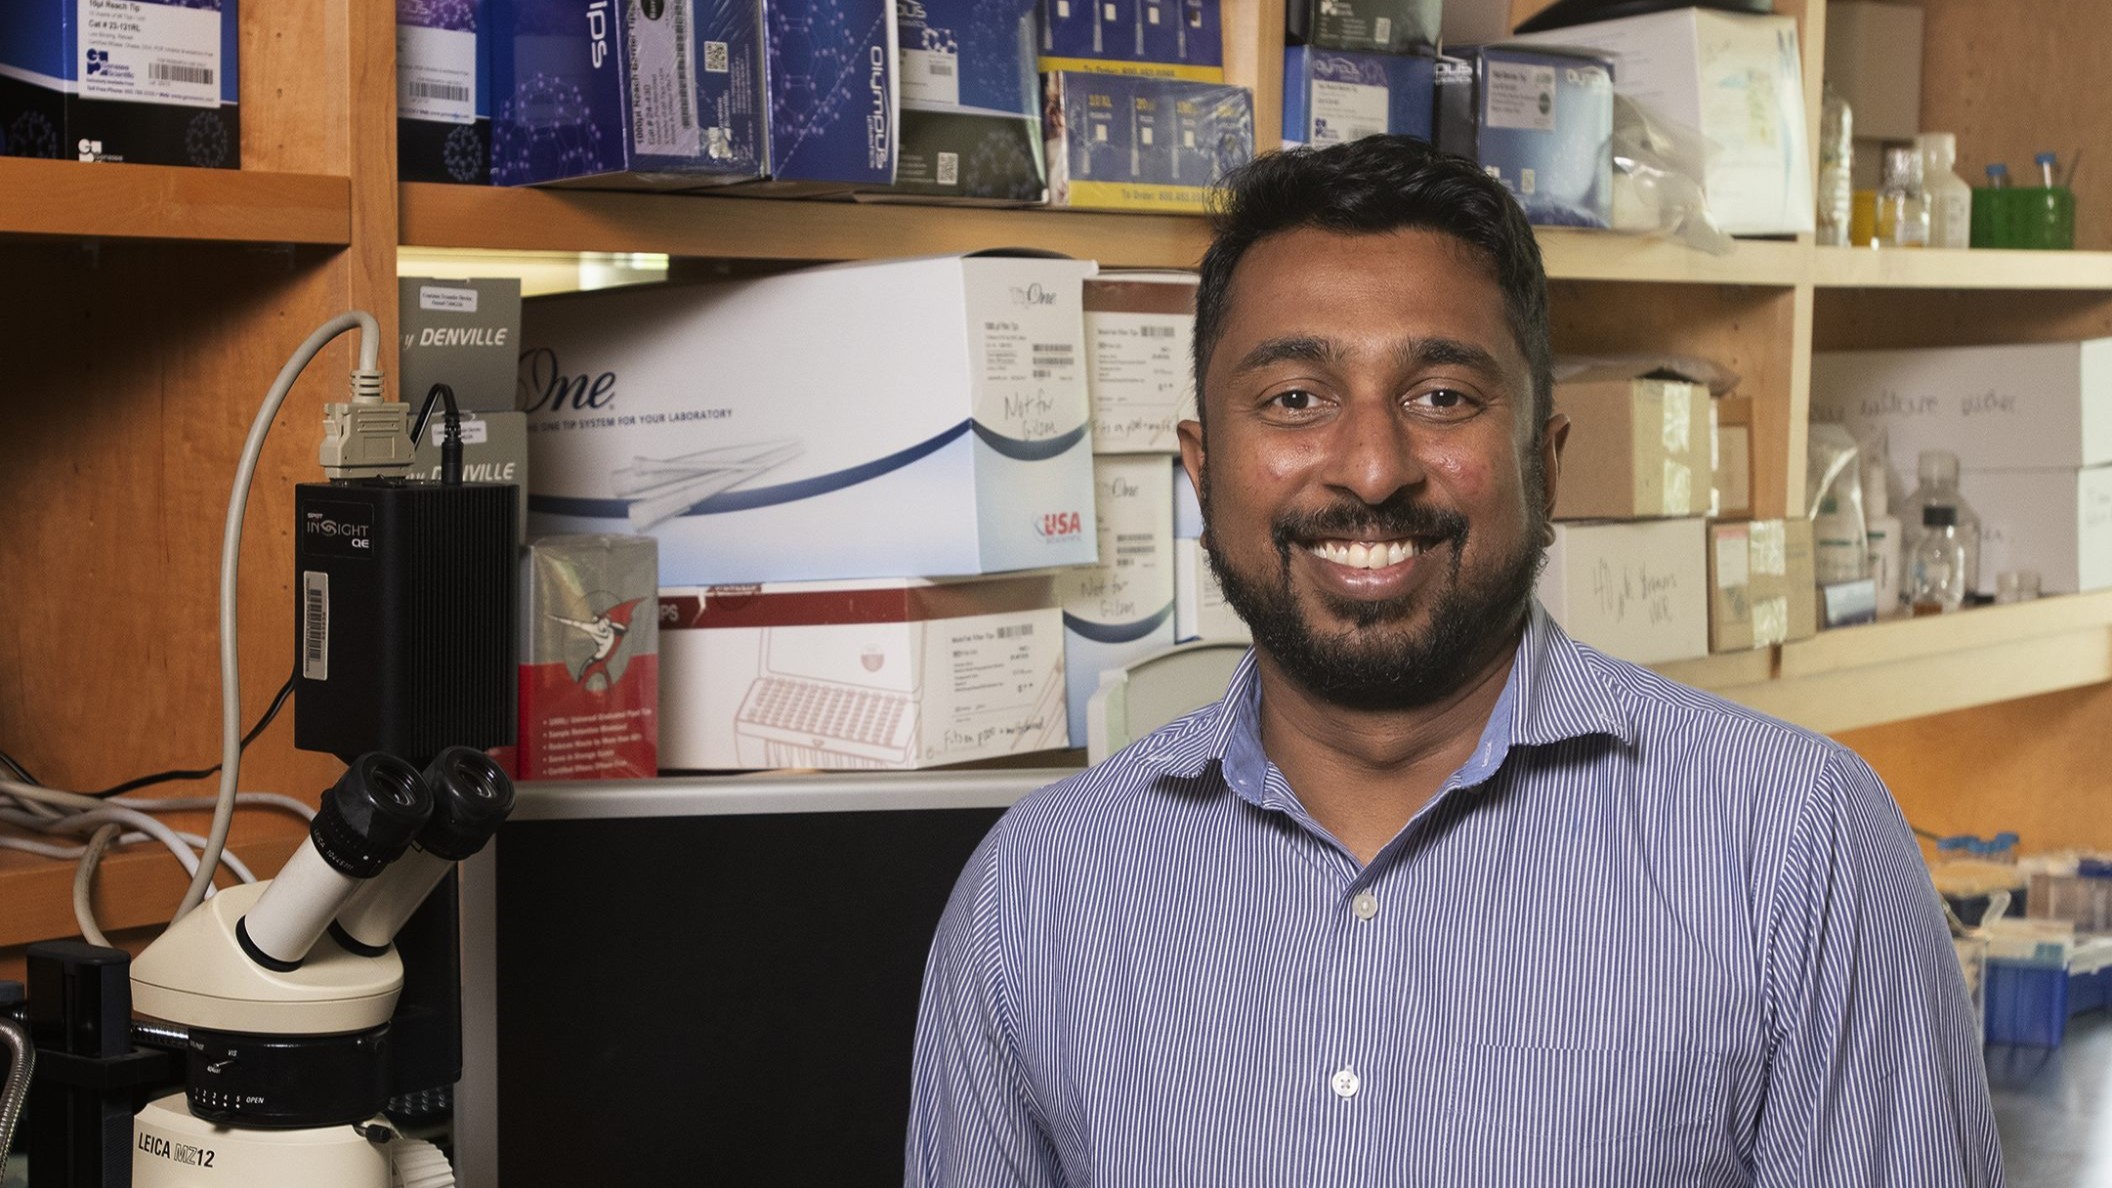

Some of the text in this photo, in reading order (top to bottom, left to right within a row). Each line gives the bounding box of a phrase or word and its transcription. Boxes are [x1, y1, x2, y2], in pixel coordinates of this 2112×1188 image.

[419, 327, 508, 347] DENVILLE
[562, 420, 577, 431] TIP
[579, 418, 616, 430] SYSTEM
[617, 416, 635, 427] FOR
[639, 413, 665, 425] YOUR
[668, 409, 733, 423] LABORATORY
[431, 462, 516, 482] DVILLE
[1043, 512, 1082, 536] USA
[245, 1096, 265, 1104] OPEN
[138, 1131, 216, 1168] LEICA MZ12
